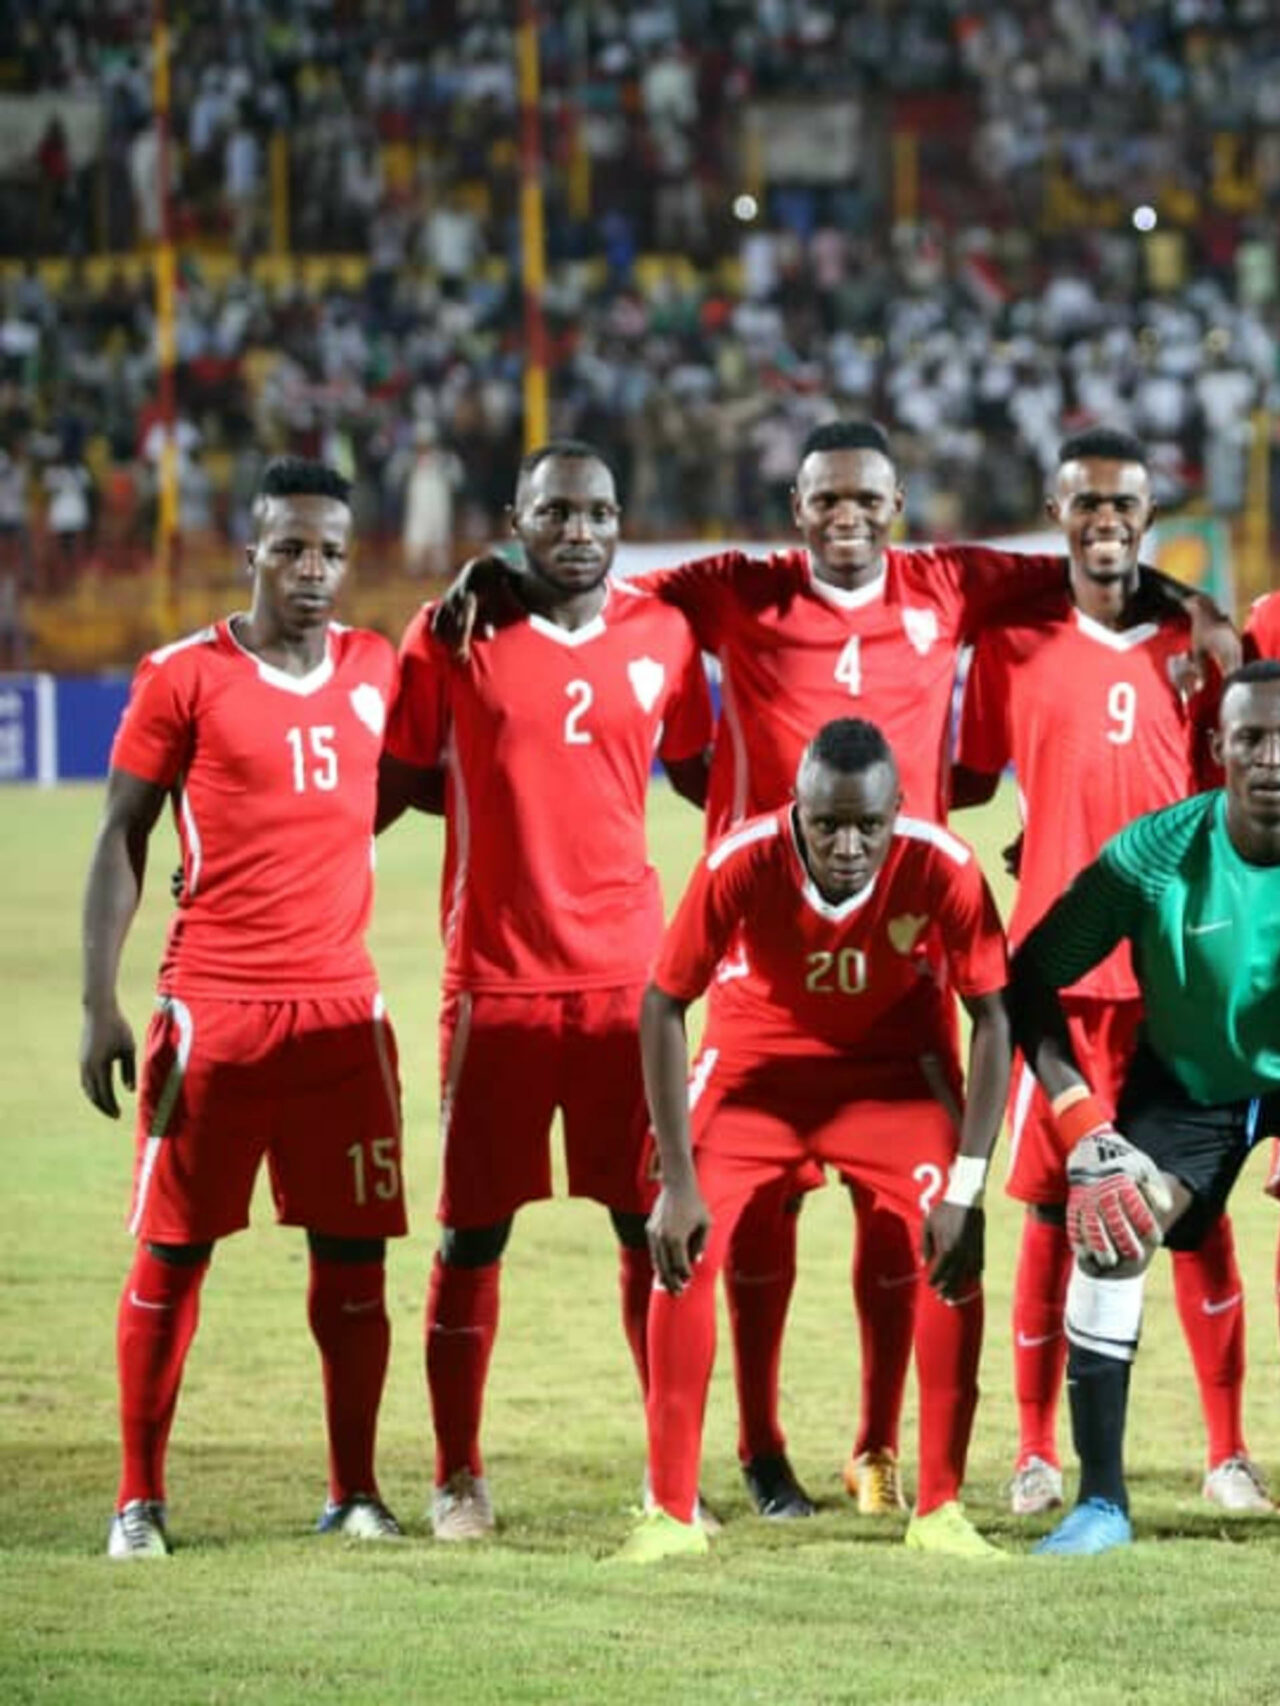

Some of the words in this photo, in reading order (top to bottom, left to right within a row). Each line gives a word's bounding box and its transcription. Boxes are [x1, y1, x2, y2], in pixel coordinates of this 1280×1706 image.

[833, 634, 862, 697] 4
[564, 678, 594, 744] 2
[1107, 681, 1137, 744] 9
[286, 725, 339, 792] 15
[806, 947, 868, 994] 20
[347, 1138, 400, 1206] 15
[913, 1163, 943, 1218] 2
